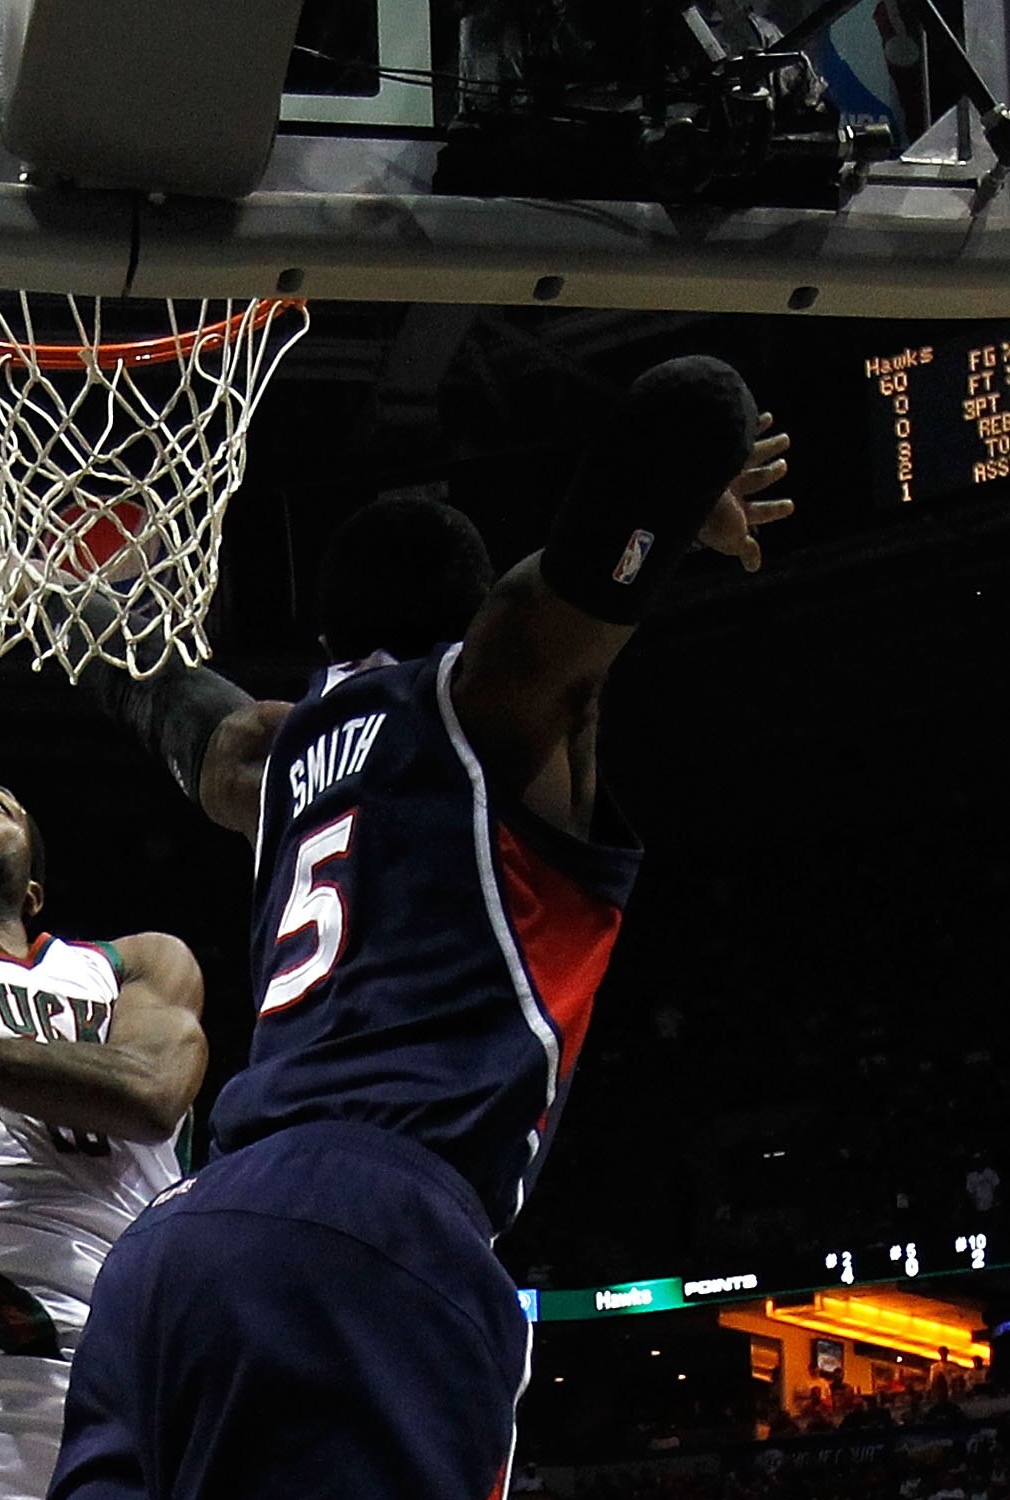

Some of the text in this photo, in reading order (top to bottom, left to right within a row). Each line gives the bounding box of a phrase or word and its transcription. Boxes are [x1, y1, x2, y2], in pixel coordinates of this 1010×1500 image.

[864, 344, 934, 378] Hawks
[967, 345, 996, 372] FG
[878, 371, 909, 396] 60
[967, 370, 994, 396] FT
[894, 394, 909, 415] 0
[895, 417, 910, 439] 0
[900, 481, 913, 502] 1
[290, 713, 387, 819] SMITH
[259, 805, 359, 1017] 5
[904, 1257, 919, 1277] 0
[971, 1248, 985, 1269] 2
[684, 1274, 758, 1297] POINTS
[595, 1287, 653, 1311] Hawks
